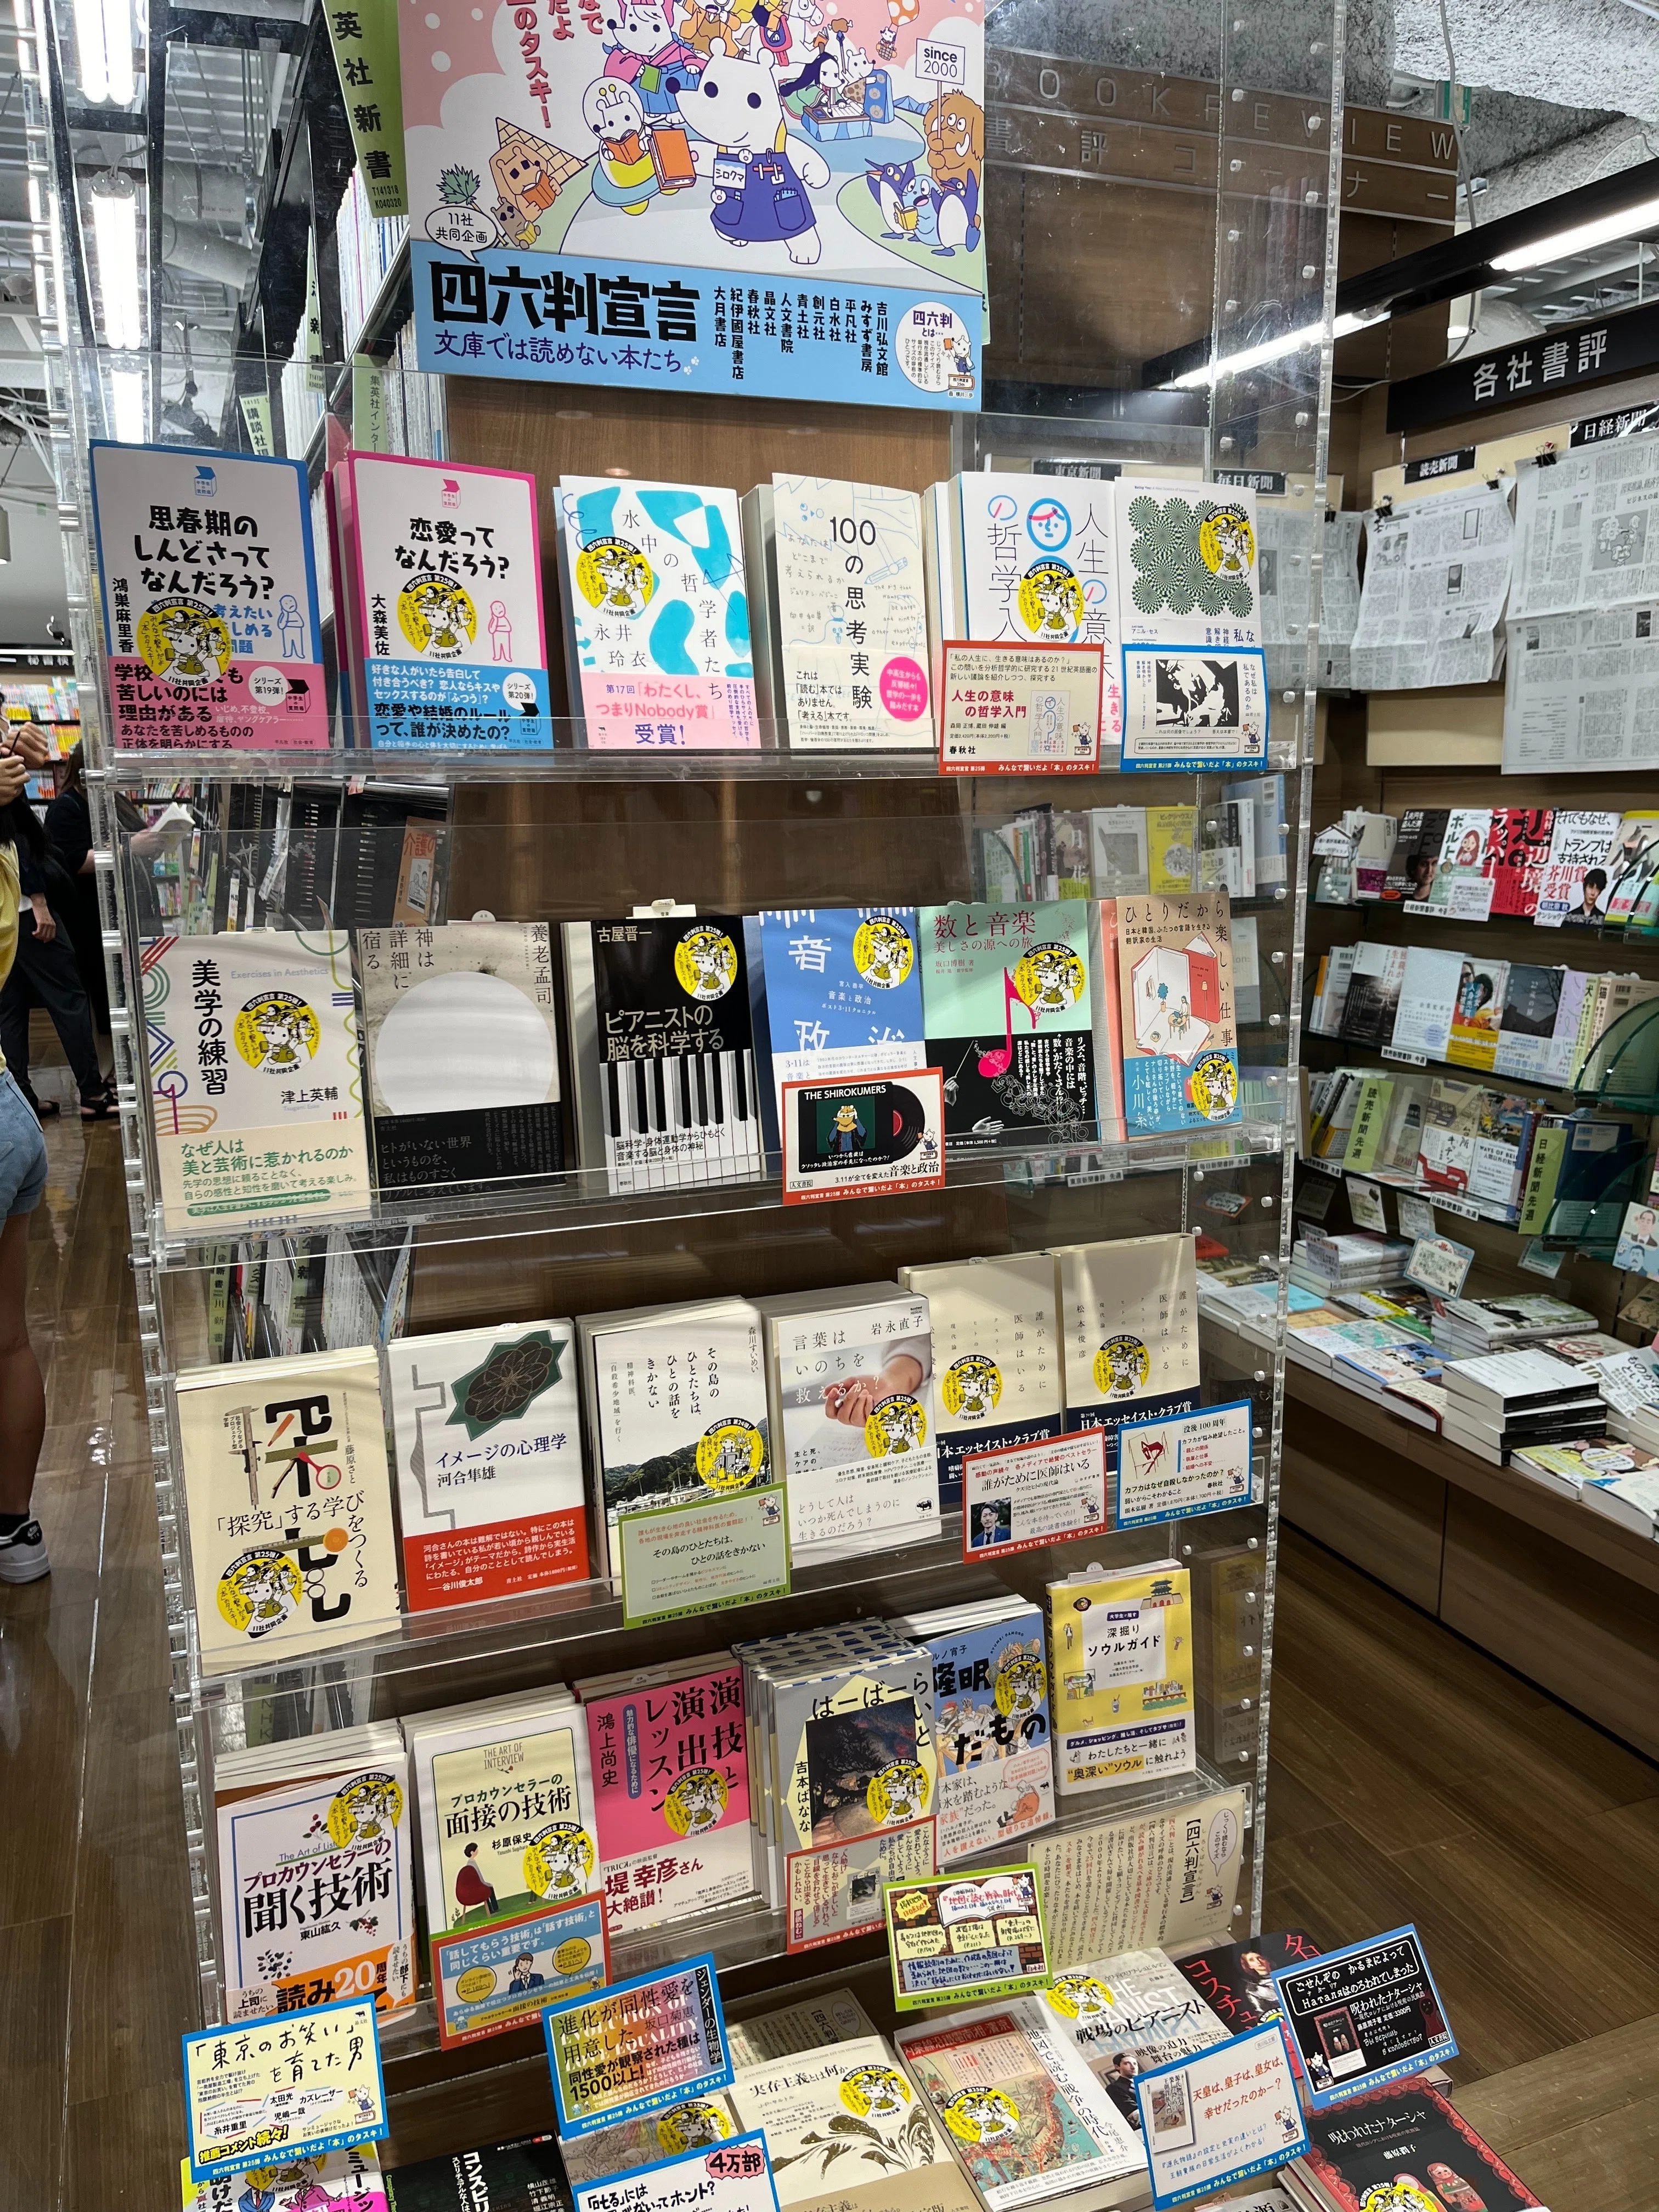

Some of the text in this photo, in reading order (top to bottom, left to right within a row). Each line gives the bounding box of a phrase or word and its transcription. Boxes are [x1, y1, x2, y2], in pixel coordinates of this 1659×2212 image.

[923, 46, 957, 63] since
[923, 60, 958, 79] 2000
[715, 168, 744, 182] シロクマ
[372, 184, 399, 198] T141318
[374, 197, 402, 209] K040320
[448, 213, 474, 226] 11社
[436, 228, 487, 242] 共同企画
[428, 261, 701, 343] 四六判宣言
[747, 289, 760, 335] 春秋社
[763, 291, 777, 336] 晶文社
[797, 293, 810, 340] 青土社
[714, 287, 726, 348] 大月書店
[781, 292, 794, 354] 人文書院
[812, 296, 825, 341] 創元社
[829, 297, 841, 342] 白水社
[845, 298, 857, 344] 平凡社
[913, 311, 952, 328] 四六判
[730, 287, 744, 380] 紀伊國屋書店
[860, 301, 873, 373] みすず書房
[876, 302, 888, 377] 吉川弘文館
[434, 330, 682, 374] 文庫では読めない本たち
[1473, 329, 1607, 401] 各社書評
[1585, 408, 1646, 439] 日経新聞
[1216, 472, 1273, 490] 毎日新聞
[1420, 456, 1458, 478] 読売新聞
[149, 505, 258, 538] 思春期の
[409, 517, 495, 549] 恋愛って
[134, 534, 270, 569] しんどさって
[395, 545, 510, 579] なんだろう？
[141, 566, 275, 600] なんだろう？
[371, 594, 390, 656] 大森美佐
[594, 624, 631, 642] 永井
[371, 664, 481, 680] 好きな人がいたら告白して
[372, 678, 501, 692] 付き合うべき？ 恋人ならキスや
[796, 670, 819, 680] これは
[1243, 663, 1251, 710] 私であるのか
[116, 684, 229, 703] 苦しいのには
[255, 686, 284, 695] 第19弾！
[796, 684, 843, 695] 「読む」本では
[951, 690, 1014, 702] 人生の意味
[119, 705, 213, 723] 理由がある
[374, 703, 511, 723] 恋愛や結婚のルール
[965, 705, 1027, 719] の哲学入門
[121, 726, 254, 737] あなたを苦しめるものの
[377, 723, 510, 742] って、誰が決めたの？
[635, 724, 685, 745] 受賞！
[949, 746, 976, 754] 春秋社
[1444, 815, 1465, 860] ボルト
[1564, 839, 1612, 853] トランプは
[1548, 866, 1588, 884] 芥川賞
[1544, 883, 1571, 900] 受賞
[597, 926, 652, 943] 古屋晋一
[933, 911, 1036, 939] 数と音楽
[1126, 923, 1210, 935] 日本と韓国、ふたつの言語を生きる
[1126, 935, 1163, 945] 翻訳家の生活
[362, 932, 382, 970] 宿る
[389, 930, 410, 989] 詳細に
[415, 928, 435, 968] 神は
[933, 938, 1033, 953] 美しさの源への旅
[531, 925, 551, 1004] 養老孟司
[192, 960, 228, 1096] 美学の練習
[605, 1005, 713, 1034] ピアニストの
[606, 1028, 724, 1061] 脳を科学する
[1065, 1037, 1076, 1089] 音楽の中には
[824, 1086, 887, 1098] SHIROKUMERS
[1132, 1076, 1147, 1130] 小川糸
[1352, 1087, 1378, 1160] 読売新聞先週
[181, 1139, 244, 1156] なぜ人は
[380, 1136, 472, 1154] ヒトがいない世界
[617, 1141, 704, 1161] 音楽する脳と身体の神秘
[182, 1147, 353, 1177] 美と芸術に惹かれるのか
[382, 1168, 457, 1184] 私はものすごく
[890, 1163, 939, 1177] 音楽と政治
[183, 1170, 302, 1189] 先学の思想に頼ることなく、
[1525, 1138, 1549, 1222] 日経新聞先週
[793, 1331, 845, 1351] 言葉は
[871, 1316, 923, 1336] 岩永直子
[796, 1353, 865, 1375] いのちを
[647, 1358, 659, 1409] きかない
[611, 1361, 622, 1443] 「自殺希少地域」を行く
[345, 1444, 356, 1484] 藤原さと
[436, 1433, 567, 1469] イメージの心理学
[437, 1465, 496, 1488] 河合隼雄
[981, 1459, 1090, 1491] 誰がために医師はいる
[1125, 1469, 1224, 1493] カフカはなぜ自殺しなかったのか？
[1124, 1488, 1181, 1504] 弱いからこそわかること
[798, 1499, 900, 1527] いつか死んでしまうのに
[653, 1536, 733, 1558] その島のひとたちは、
[691, 1543, 765, 1565] ひとの話をきかない
[252, 1614, 288, 1632] 11社共同企画
[1107, 1624, 1139, 1639] 深掘り
[1088, 1635, 1161, 1658] ソウルガイド
[933, 1658, 990, 1699] 隆明
[672, 1686, 707, 1771] 演出
[954, 1713, 1047, 1765] だもの
[483, 1742, 523, 1758] THE ART OF
[484, 1752, 524, 1770] INTERVIEW
[597, 1714, 618, 1788] 鴻上尚史
[1087, 1739, 1167, 1760] わたしたちと一緒に
[451, 1773, 563, 1809] プロカウンセラーの
[795, 1760, 811, 1832] 吉本ばなな
[445, 1786, 572, 1838] 面接の技術
[244, 1838, 392, 1894] プロカウンセラーの
[279, 1846, 321, 1861] The Art of
[1180, 1819, 1201, 1904] 【四六判宣言】
[605, 1857, 703, 1897] 堤 幸彦さん
[244, 1858, 393, 1939] 聞く技術
[1296, 1946, 1405, 1993] ごせんぞの かるまによって
[558, 1978, 695, 2037] 進化が同性愛を
[1350, 1982, 1423, 2016] 呪われたナターシャ
[697, 1969, 723, 2064] ジェンダーの生物学
[1076, 1998, 1206, 2044] 戦場のピアニスト
[196, 2023, 354, 2070] 「東京のお笑い」
[270, 2036, 363, 2083] を育てた男
[562, 2028, 635, 2064] 用意した
[569, 2033, 701, 2086] 同性愛が観察された種は
[1135, 2038, 1187, 2058] 映像の迫力
[569, 2067, 644, 2101] 1500以上！
[749, 2064, 849, 2097] 実存主義とは何か
[1028, 2030, 1109, 2137] 地図で読む戦争の時代
[1193, 2056, 1284, 2103] 天皇は、皇子は、皇女は、
[270, 2093, 294, 2104] 太田光
[300, 2090, 343, 2104] カズレーザー
[214, 2121, 247, 2136] 糸井重里
[1328, 2109, 1427, 2145] 呪われたナターシャ
[709, 2151, 762, 2174] 4万部
[1383, 2143, 1417, 2161] 藤原潤子
